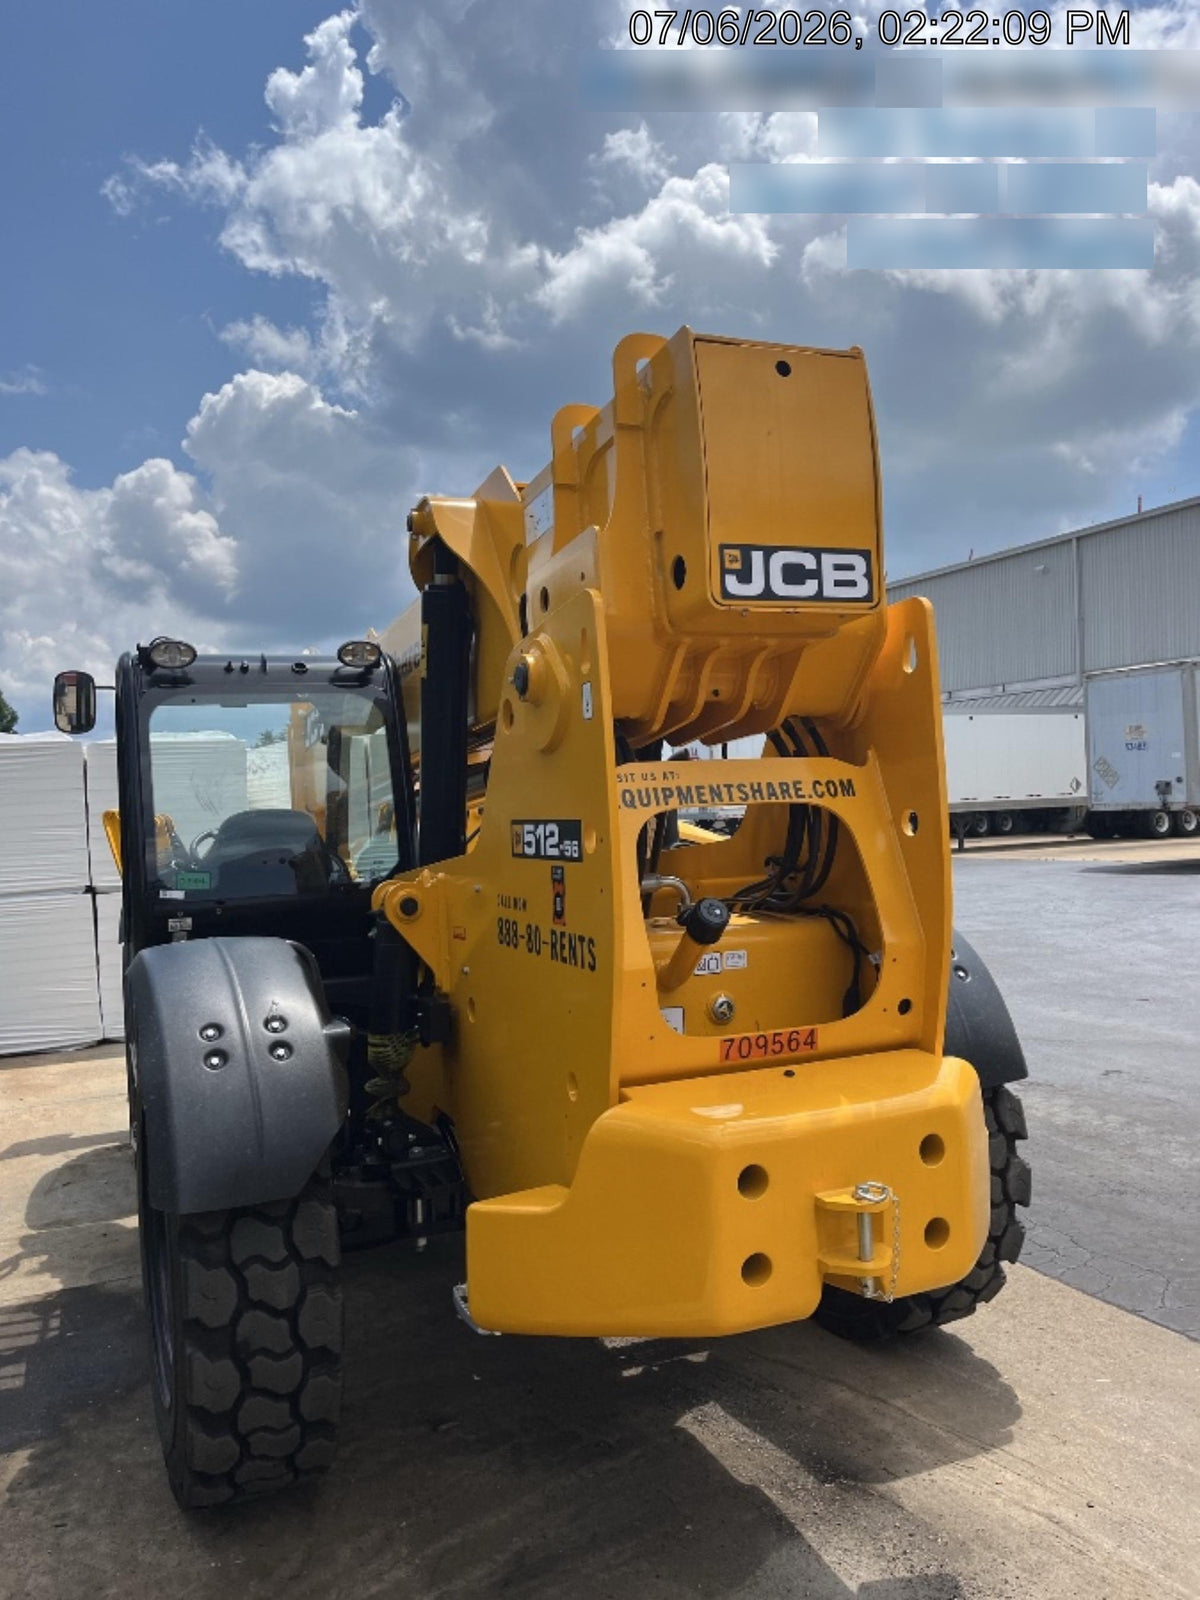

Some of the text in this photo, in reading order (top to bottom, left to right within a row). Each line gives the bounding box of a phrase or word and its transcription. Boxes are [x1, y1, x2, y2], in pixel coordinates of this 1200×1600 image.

[724, 550, 870, 599] JCB
[618, 779, 857, 809] QUIPMENTSHARE.COM
[497, 916, 597, 972] 888-80-RENTS
[722, 1028, 817, 1061] 709564
